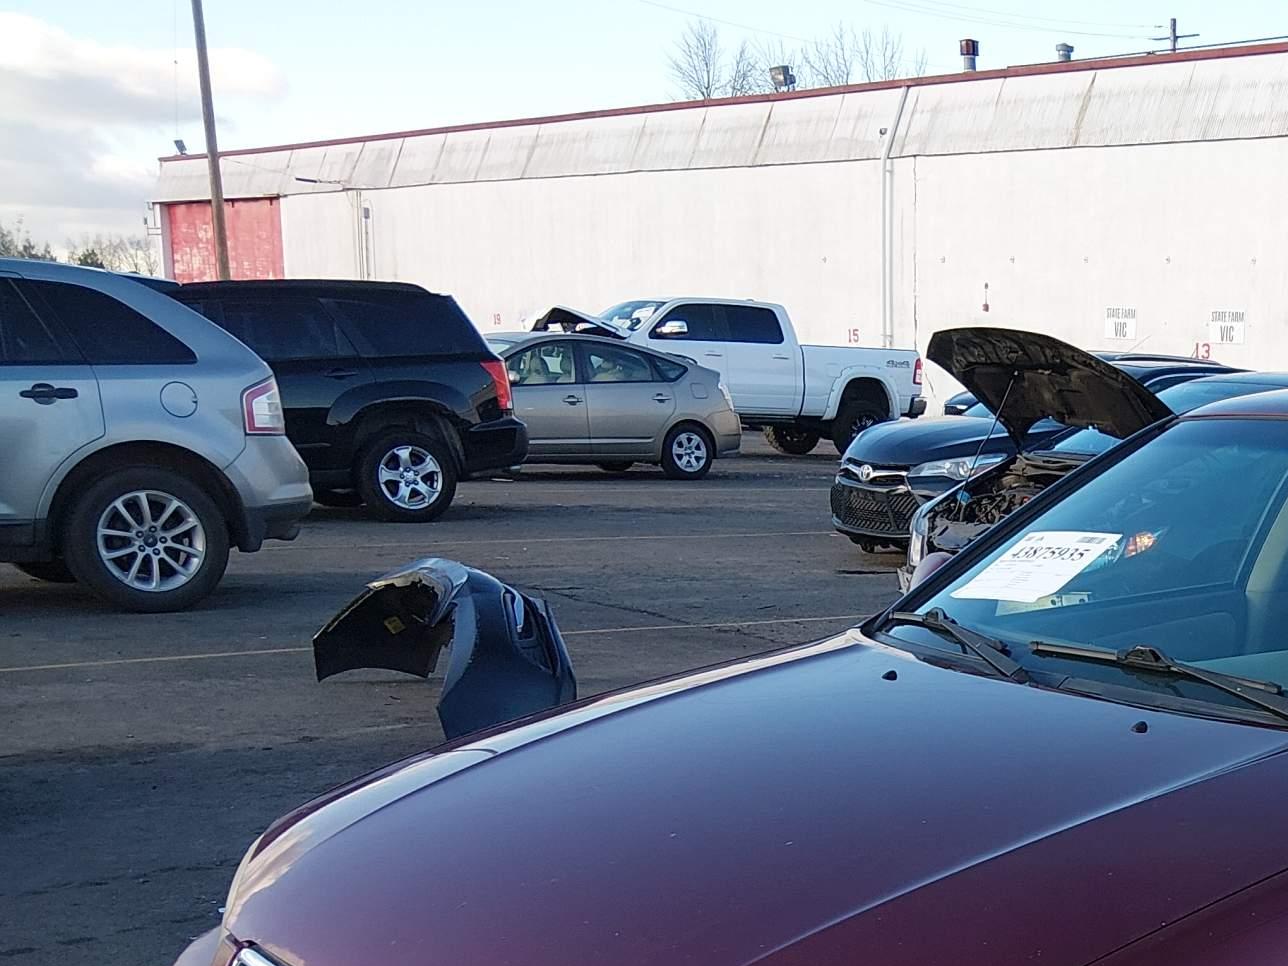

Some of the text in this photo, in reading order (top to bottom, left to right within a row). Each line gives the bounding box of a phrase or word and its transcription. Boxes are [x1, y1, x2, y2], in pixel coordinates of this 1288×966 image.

[1106, 307, 1136, 320] STATE FARM
[1211, 311, 1245, 323] STATE FARM
[848, 328, 859, 343] 15
[1114, 322, 1127, 338] VIC
[1220, 325, 1234, 342] VIC
[1195, 342, 1211, 360] 13
